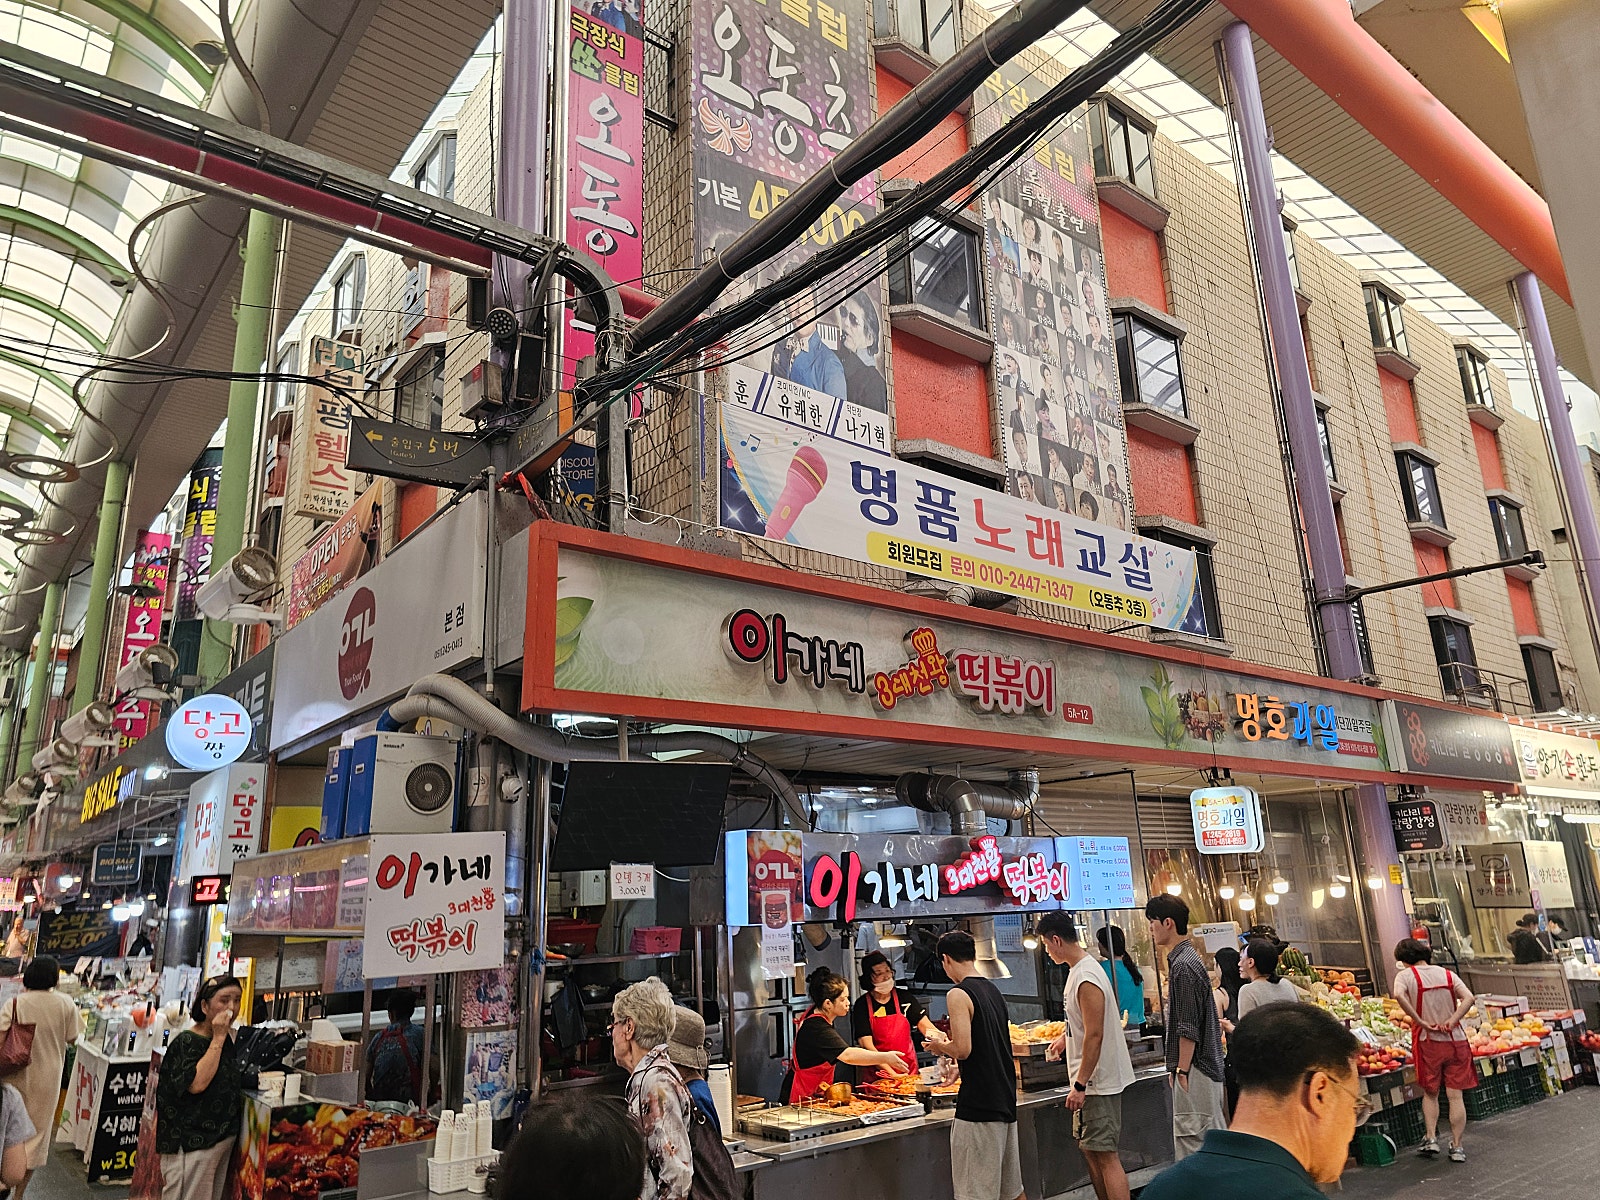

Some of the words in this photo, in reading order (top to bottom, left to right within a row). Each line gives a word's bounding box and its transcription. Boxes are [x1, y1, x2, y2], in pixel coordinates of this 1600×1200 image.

[571, 12, 625, 57] 극장식
[604, 61, 640, 97] 클럽
[699, 177, 742, 212] 기본
[734, 379, 750, 405] 훈
[778, 393, 823, 429] 유쾌한
[846, 418, 886, 449] 나기혁
[311, 528, 340, 575] OPEN
[887, 541, 943, 572] 회원모집
[951, 555, 976, 580] 문의
[979, 563, 1074, 602] 010-2447-1347
[1089, 589, 1125, 614] (오동추
[1126, 598, 1148, 620] 3층)
[444, 602, 465, 634] 본점
[728, 608, 866, 695] 이가네
[875, 652, 948, 710] 3대천왕
[955, 652, 1056, 715] 떡볶이
[184, 710, 246, 739] 당고
[1067, 708, 1089, 721] 5A-12
[204, 742, 226, 759] 짱
[194, 801, 213, 849] 당고
[228, 794, 258, 839] 당고
[1198, 807, 1246, 829] 명호과일
[376, 852, 492, 898] 이가네
[810, 850, 940, 923] 이가네
[1004, 854, 1070, 905] 떡볶이
[448, 890, 496, 916] 3대천왕
[389, 915, 478, 962] 떡볶이
[109, 1071, 143, 1095] 수박
[102, 1115, 137, 1137] 식혜
